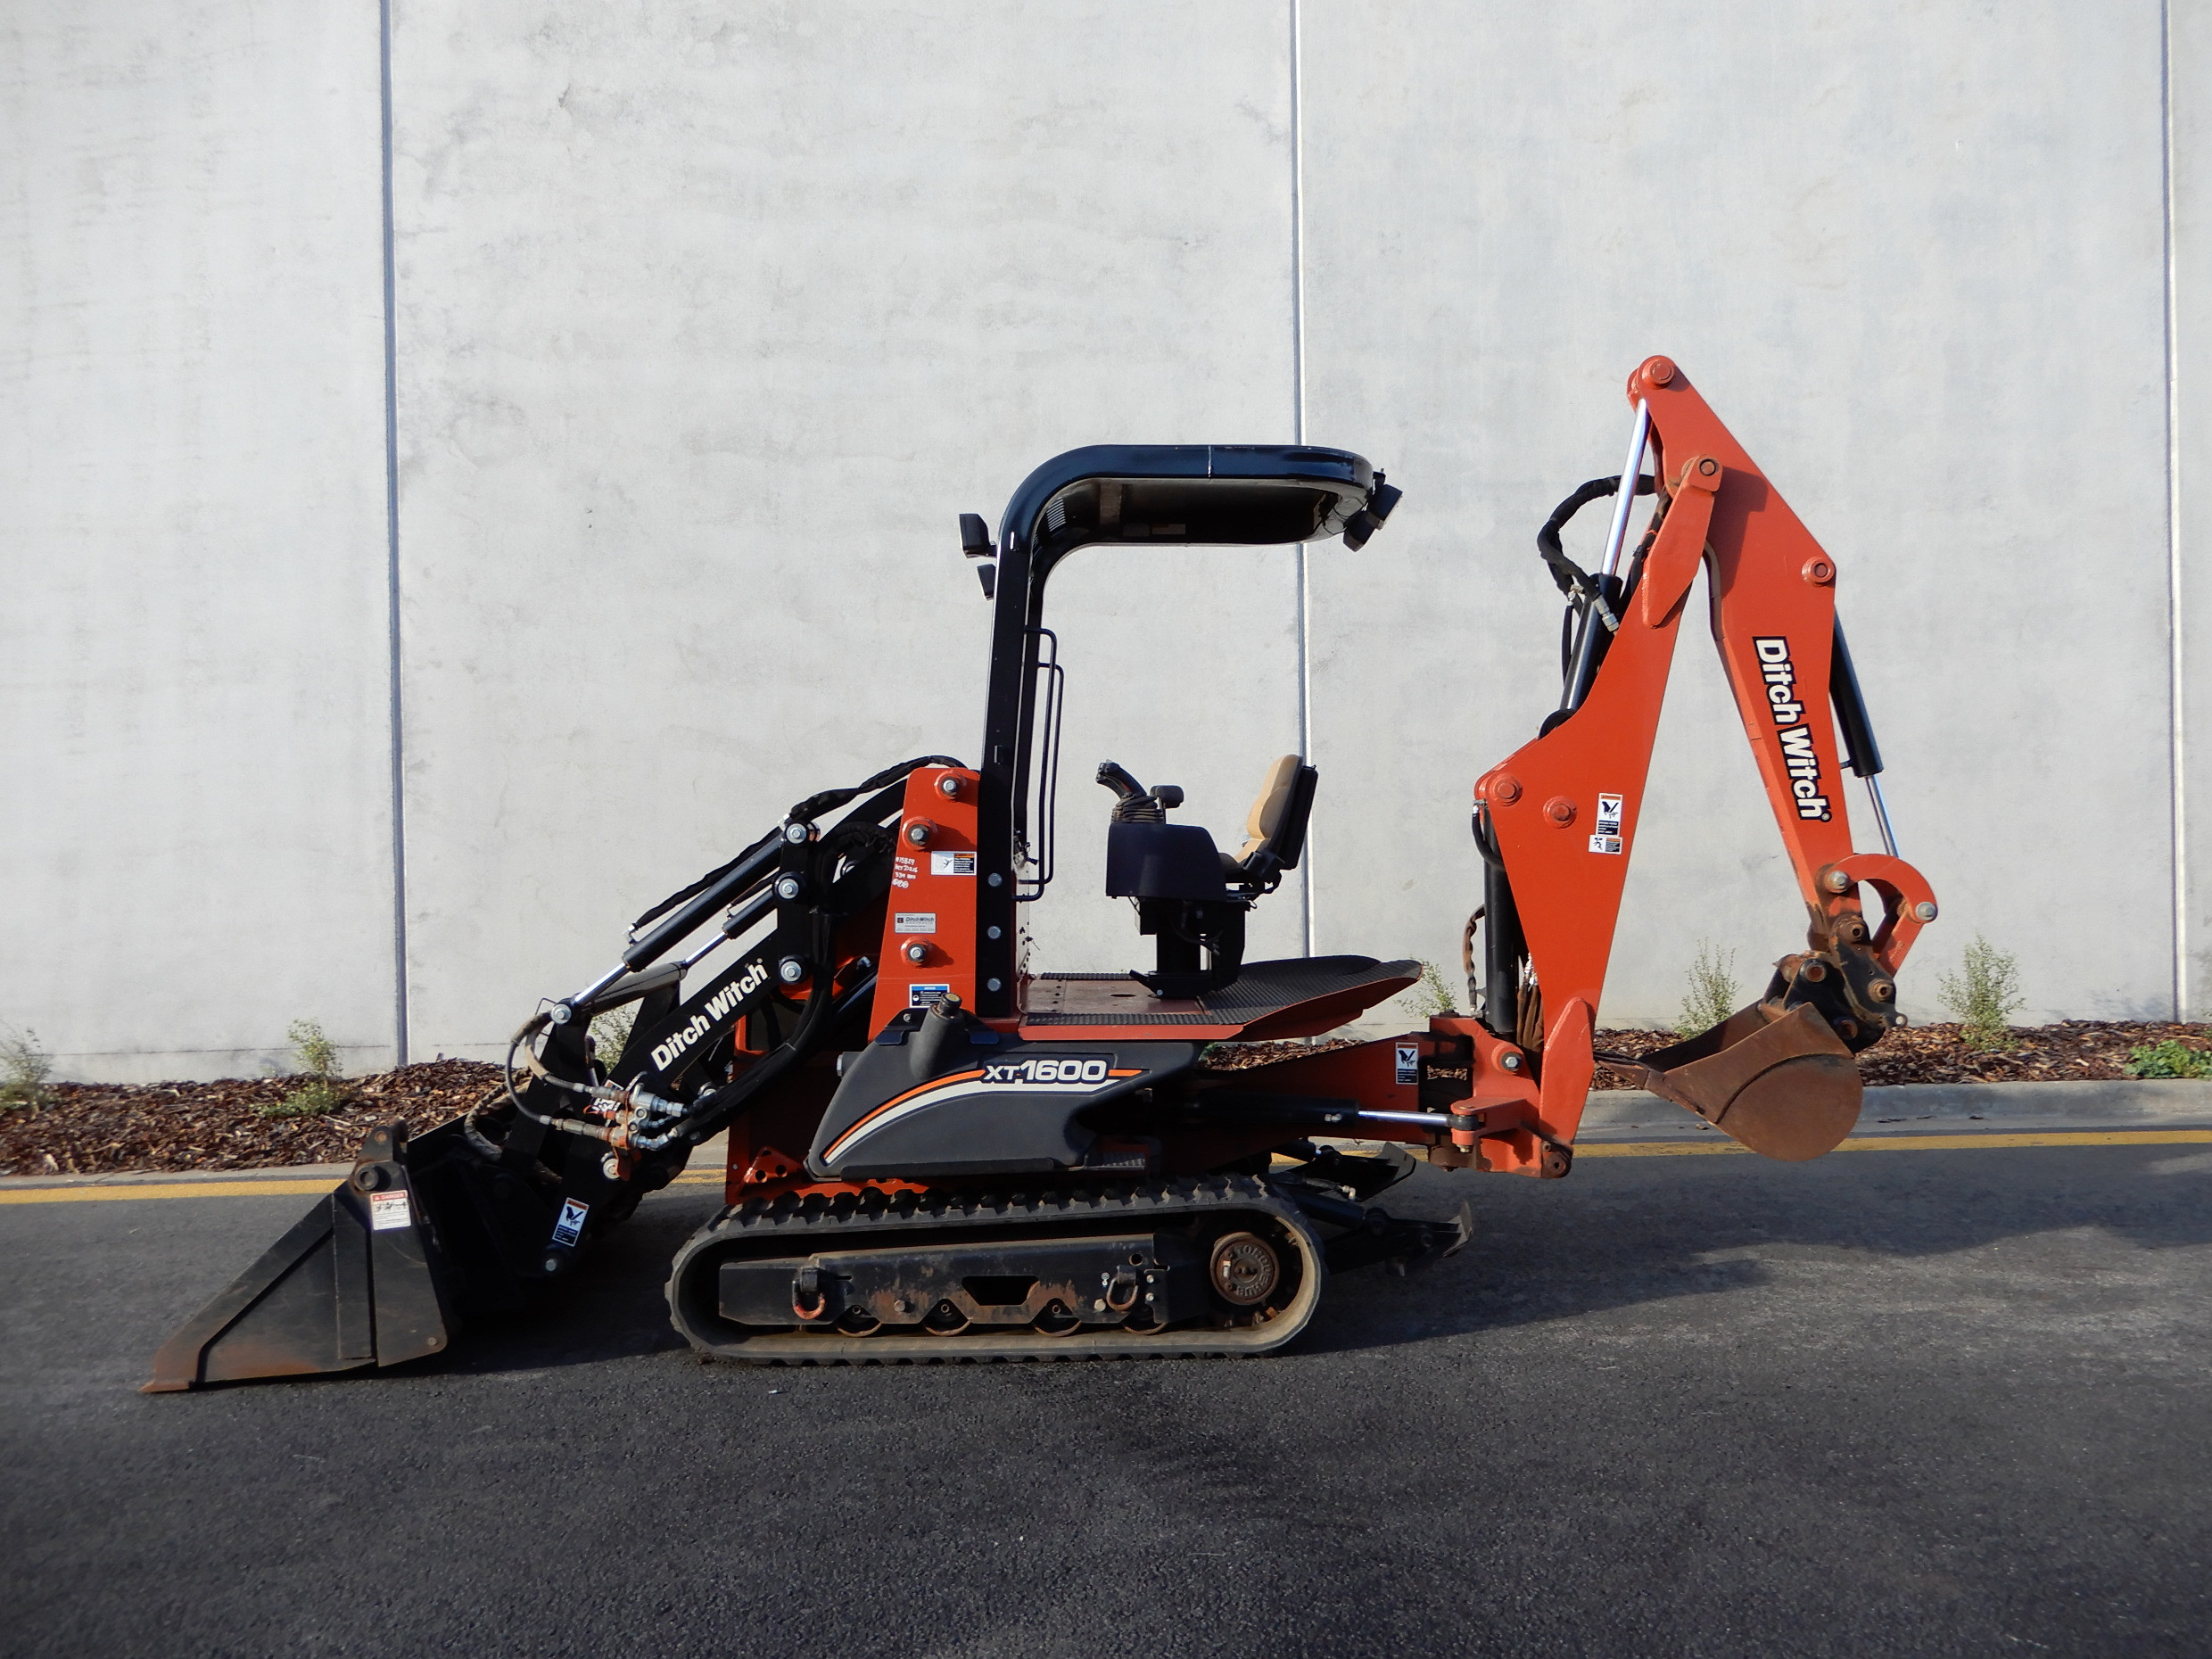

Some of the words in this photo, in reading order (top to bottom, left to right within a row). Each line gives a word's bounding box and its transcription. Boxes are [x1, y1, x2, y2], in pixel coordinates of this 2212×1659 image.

[1755, 640, 1803, 724] Ditch
[1780, 727, 1828, 819] Witch
[650, 1015, 711, 1071] Ditch
[704, 964, 769, 1021] Witch
